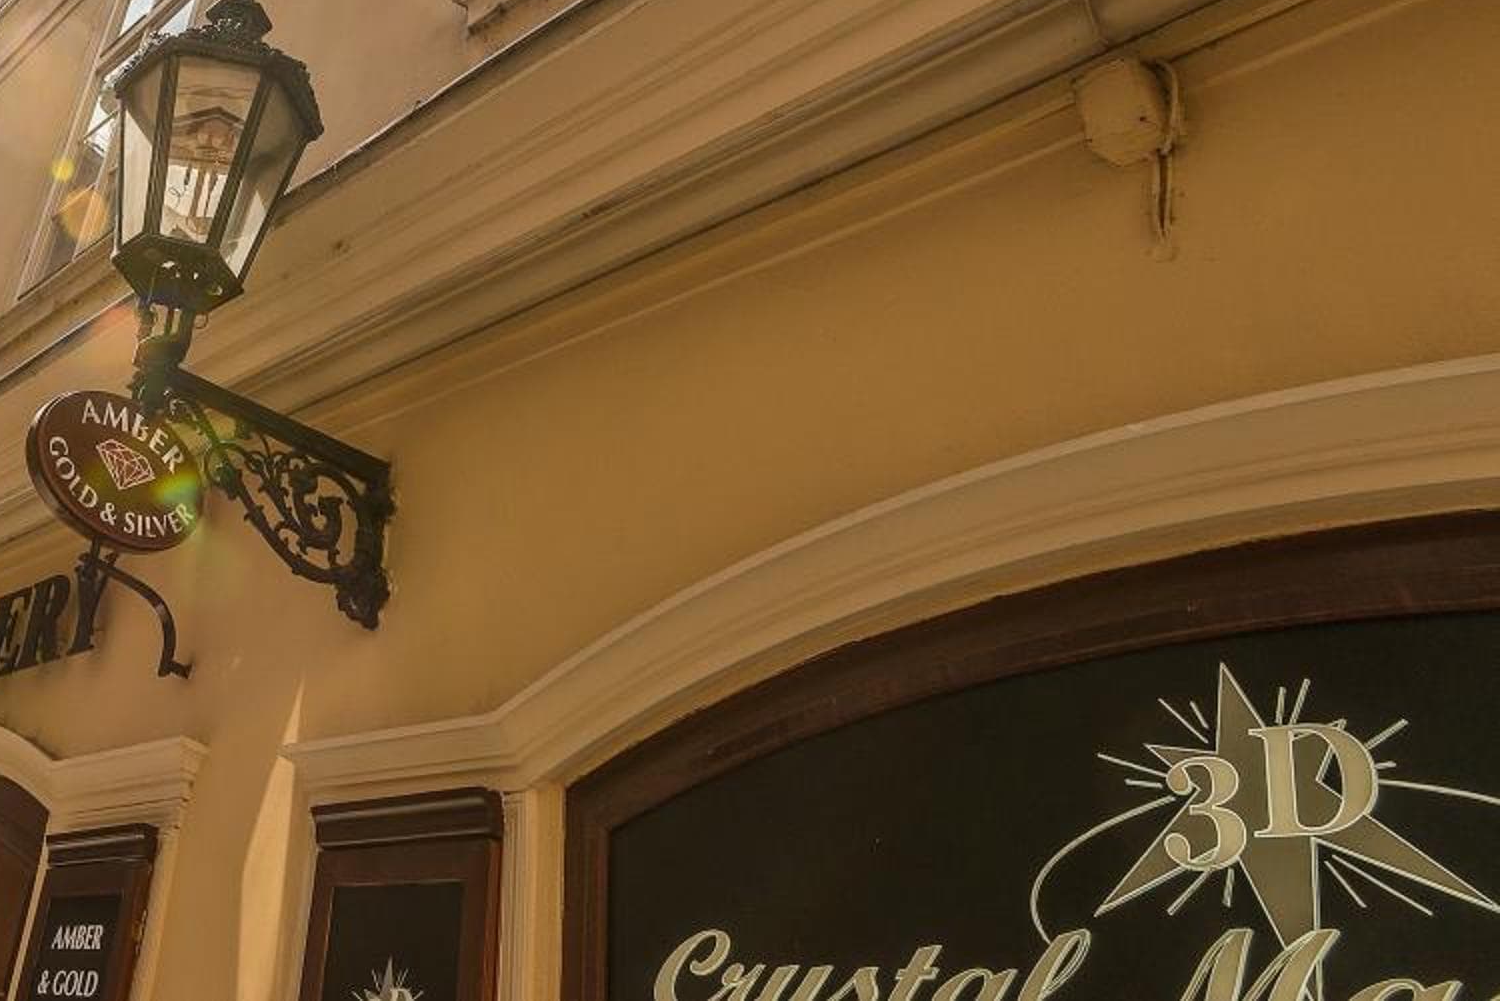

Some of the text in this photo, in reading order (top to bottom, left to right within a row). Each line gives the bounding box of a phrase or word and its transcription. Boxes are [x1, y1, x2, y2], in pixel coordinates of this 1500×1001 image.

[81, 399, 184, 474] AMBER
[49, 436, 194, 538] GOLD & SILVER
[1164, 723, 1378, 871] 3D
[51, 924, 104, 950] AMBER
[1180, 928, 1500, 1001] Ma
[37, 970, 99, 997] & GOLD
